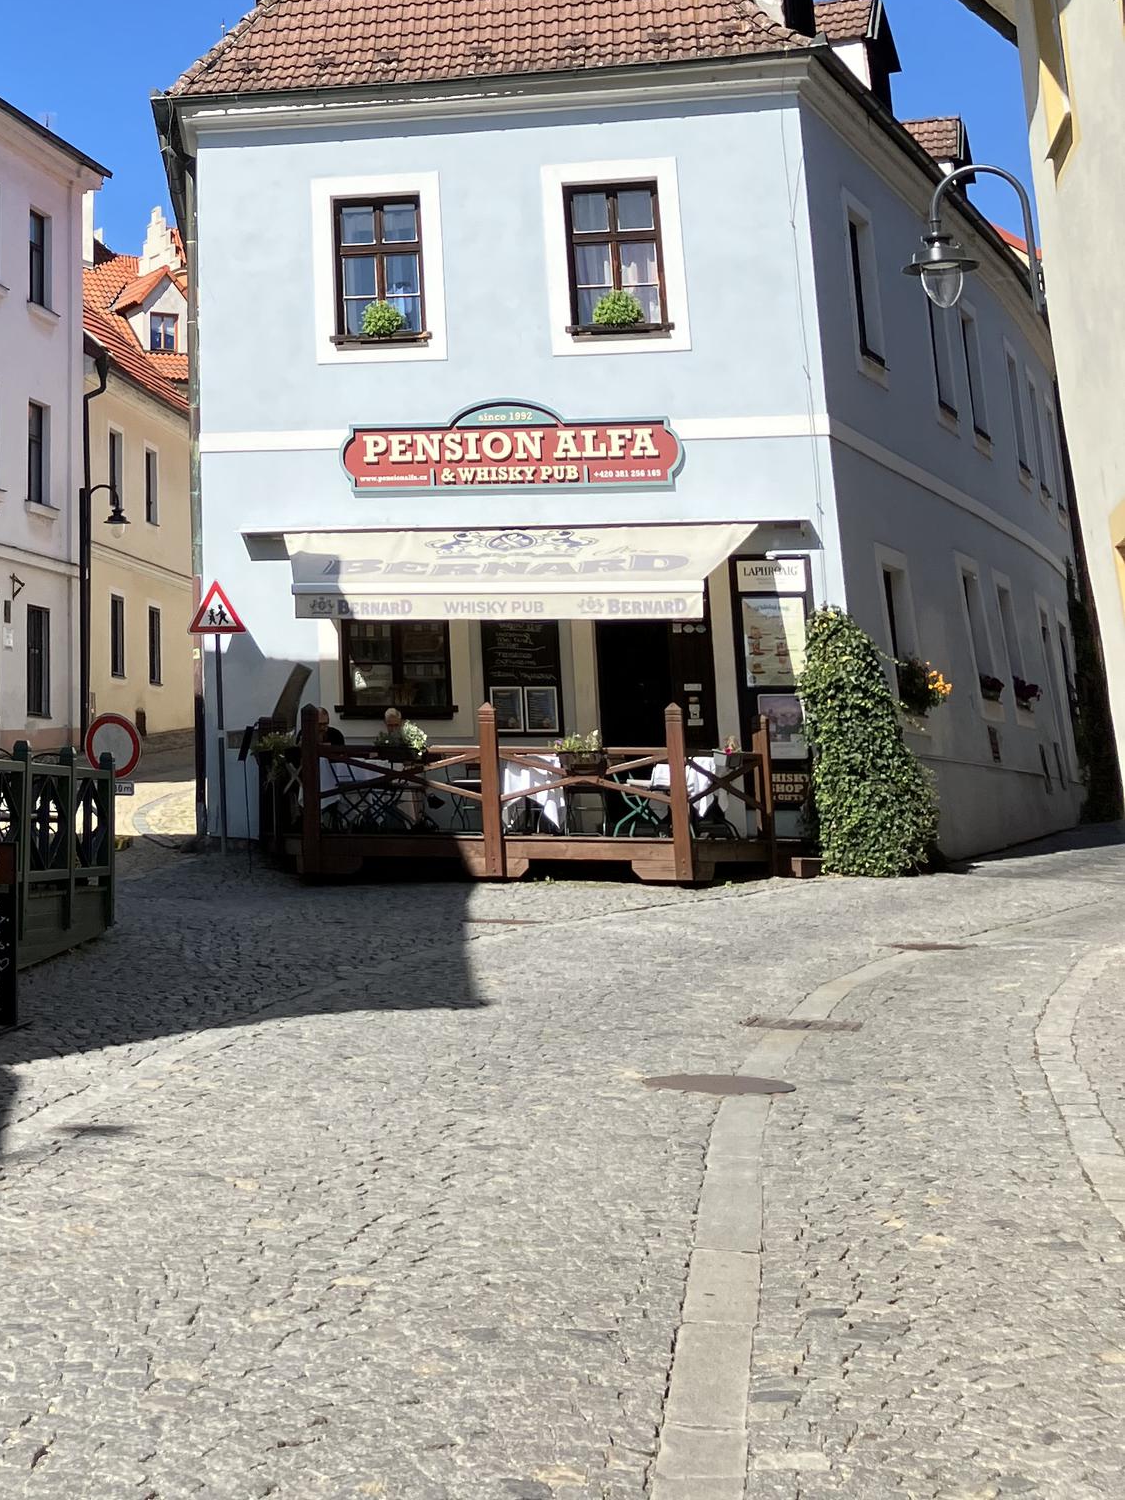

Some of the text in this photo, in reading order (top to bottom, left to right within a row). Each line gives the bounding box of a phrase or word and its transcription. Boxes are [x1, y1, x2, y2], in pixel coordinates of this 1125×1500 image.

[478, 411, 533, 422] since 1992
[363, 428, 660, 463] PENSION ALFA
[440, 464, 579, 482] & WHISKY PUB
[593, 470, 614, 478] +420
[323, 554, 691, 577] BERNARD
[338, 599, 413, 616] BERNARD
[443, 601, 545, 614] WHISKY PUB
[607, 599, 687, 615] BERNARD
[771, 773, 809, 783] HISKY
